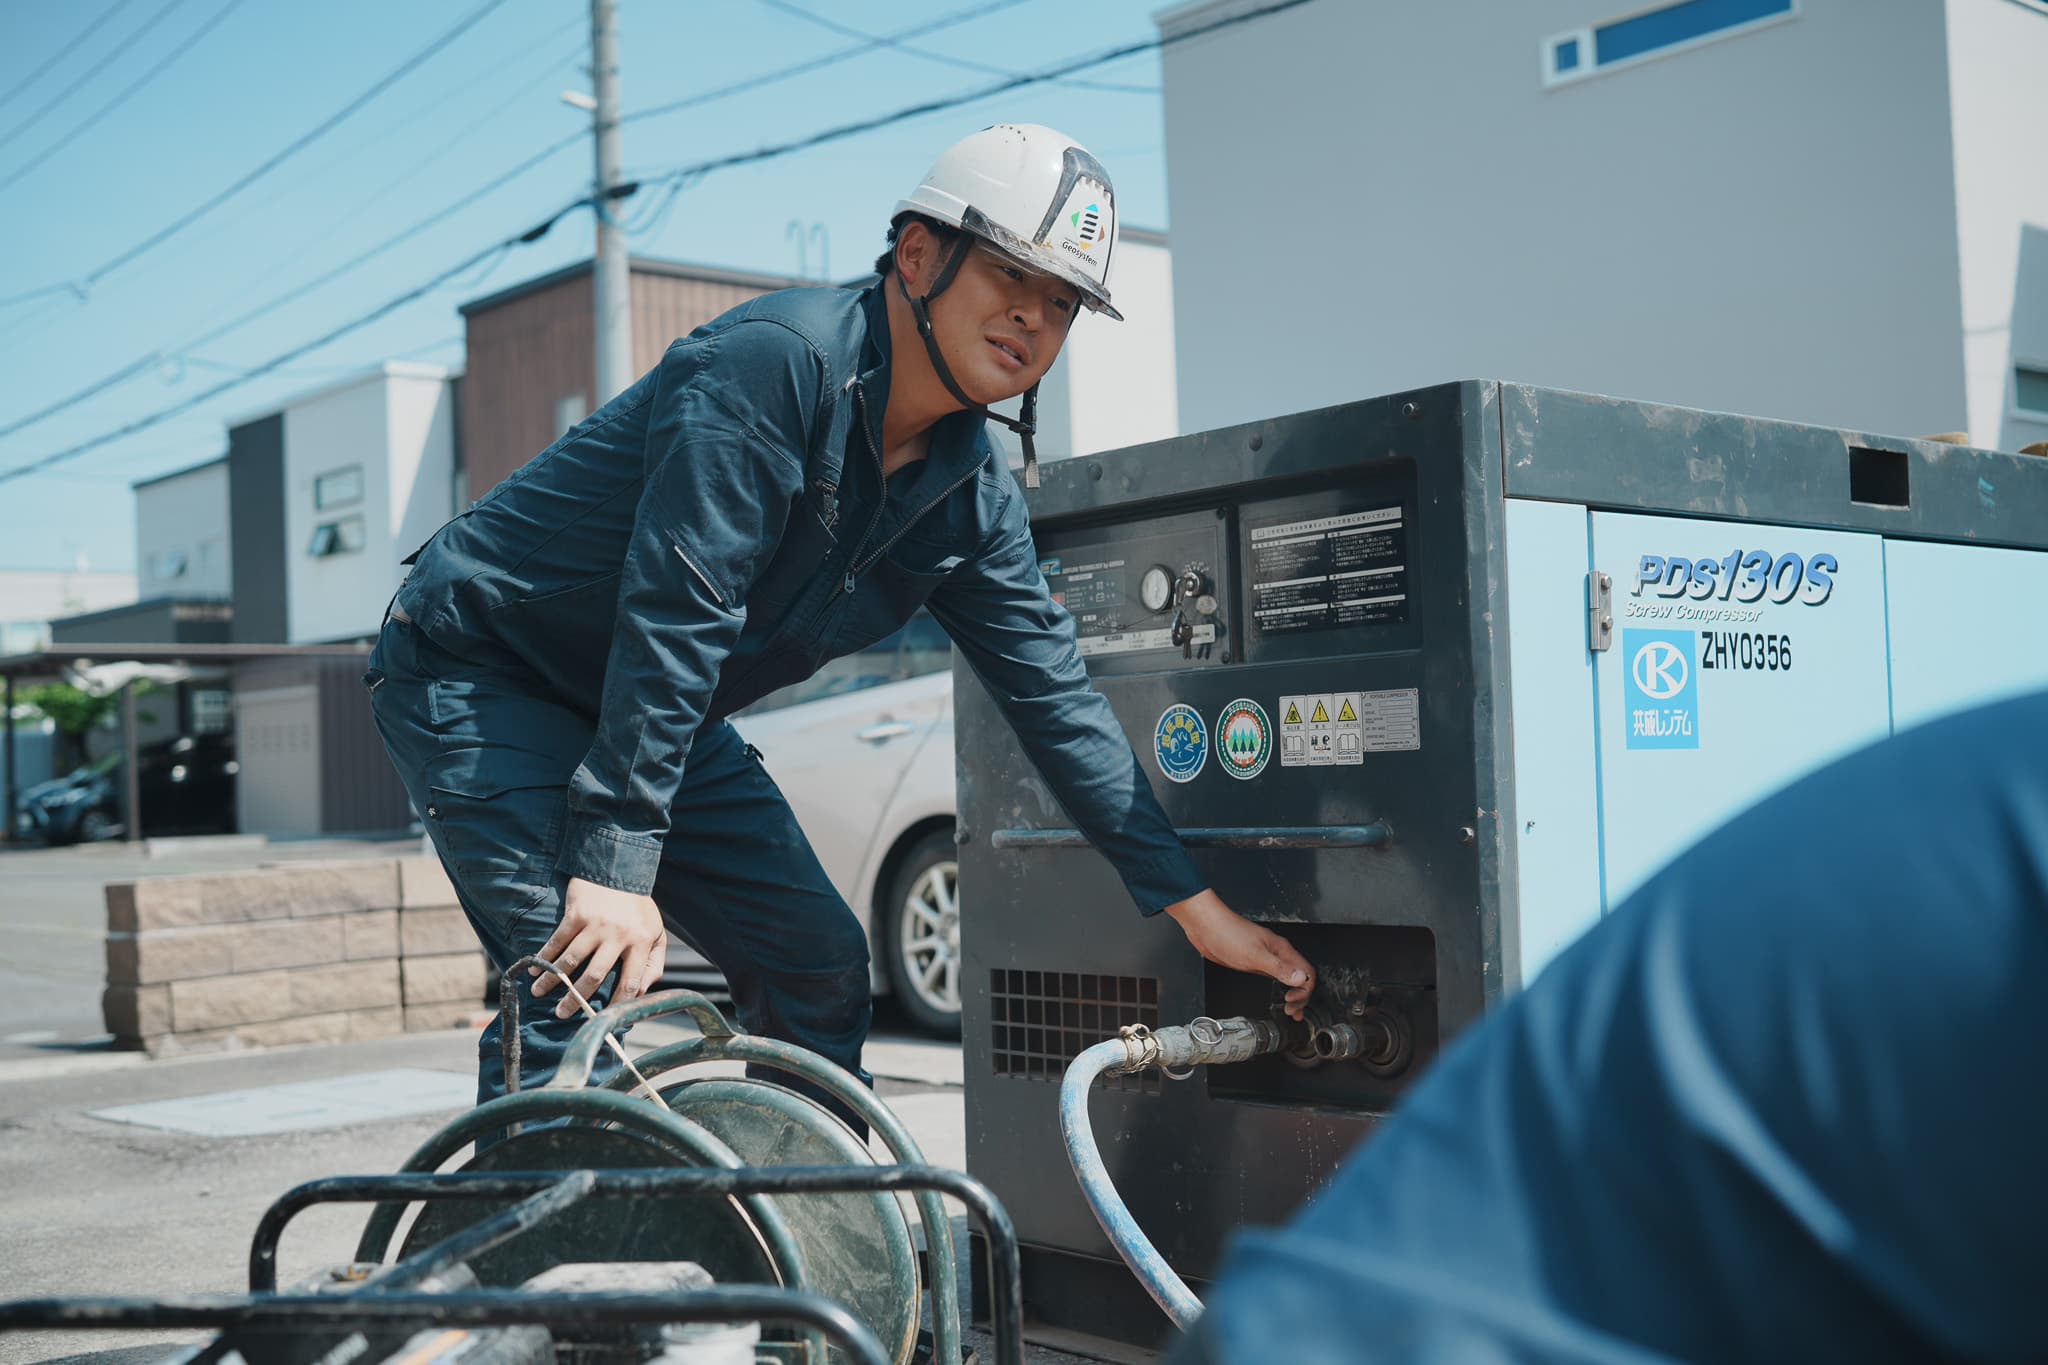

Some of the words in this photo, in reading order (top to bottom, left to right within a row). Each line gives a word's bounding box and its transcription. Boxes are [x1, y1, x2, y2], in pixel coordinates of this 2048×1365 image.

[1062, 241, 1098, 266] Geosystem
[1630, 549, 1838, 607] PDS130S
[1624, 601, 1673, 619] Screw
[1675, 603, 1763, 624] Compressor
[1701, 631, 1792, 671] ZHY0356
[1632, 709, 1692, 737] 共成レンテム
